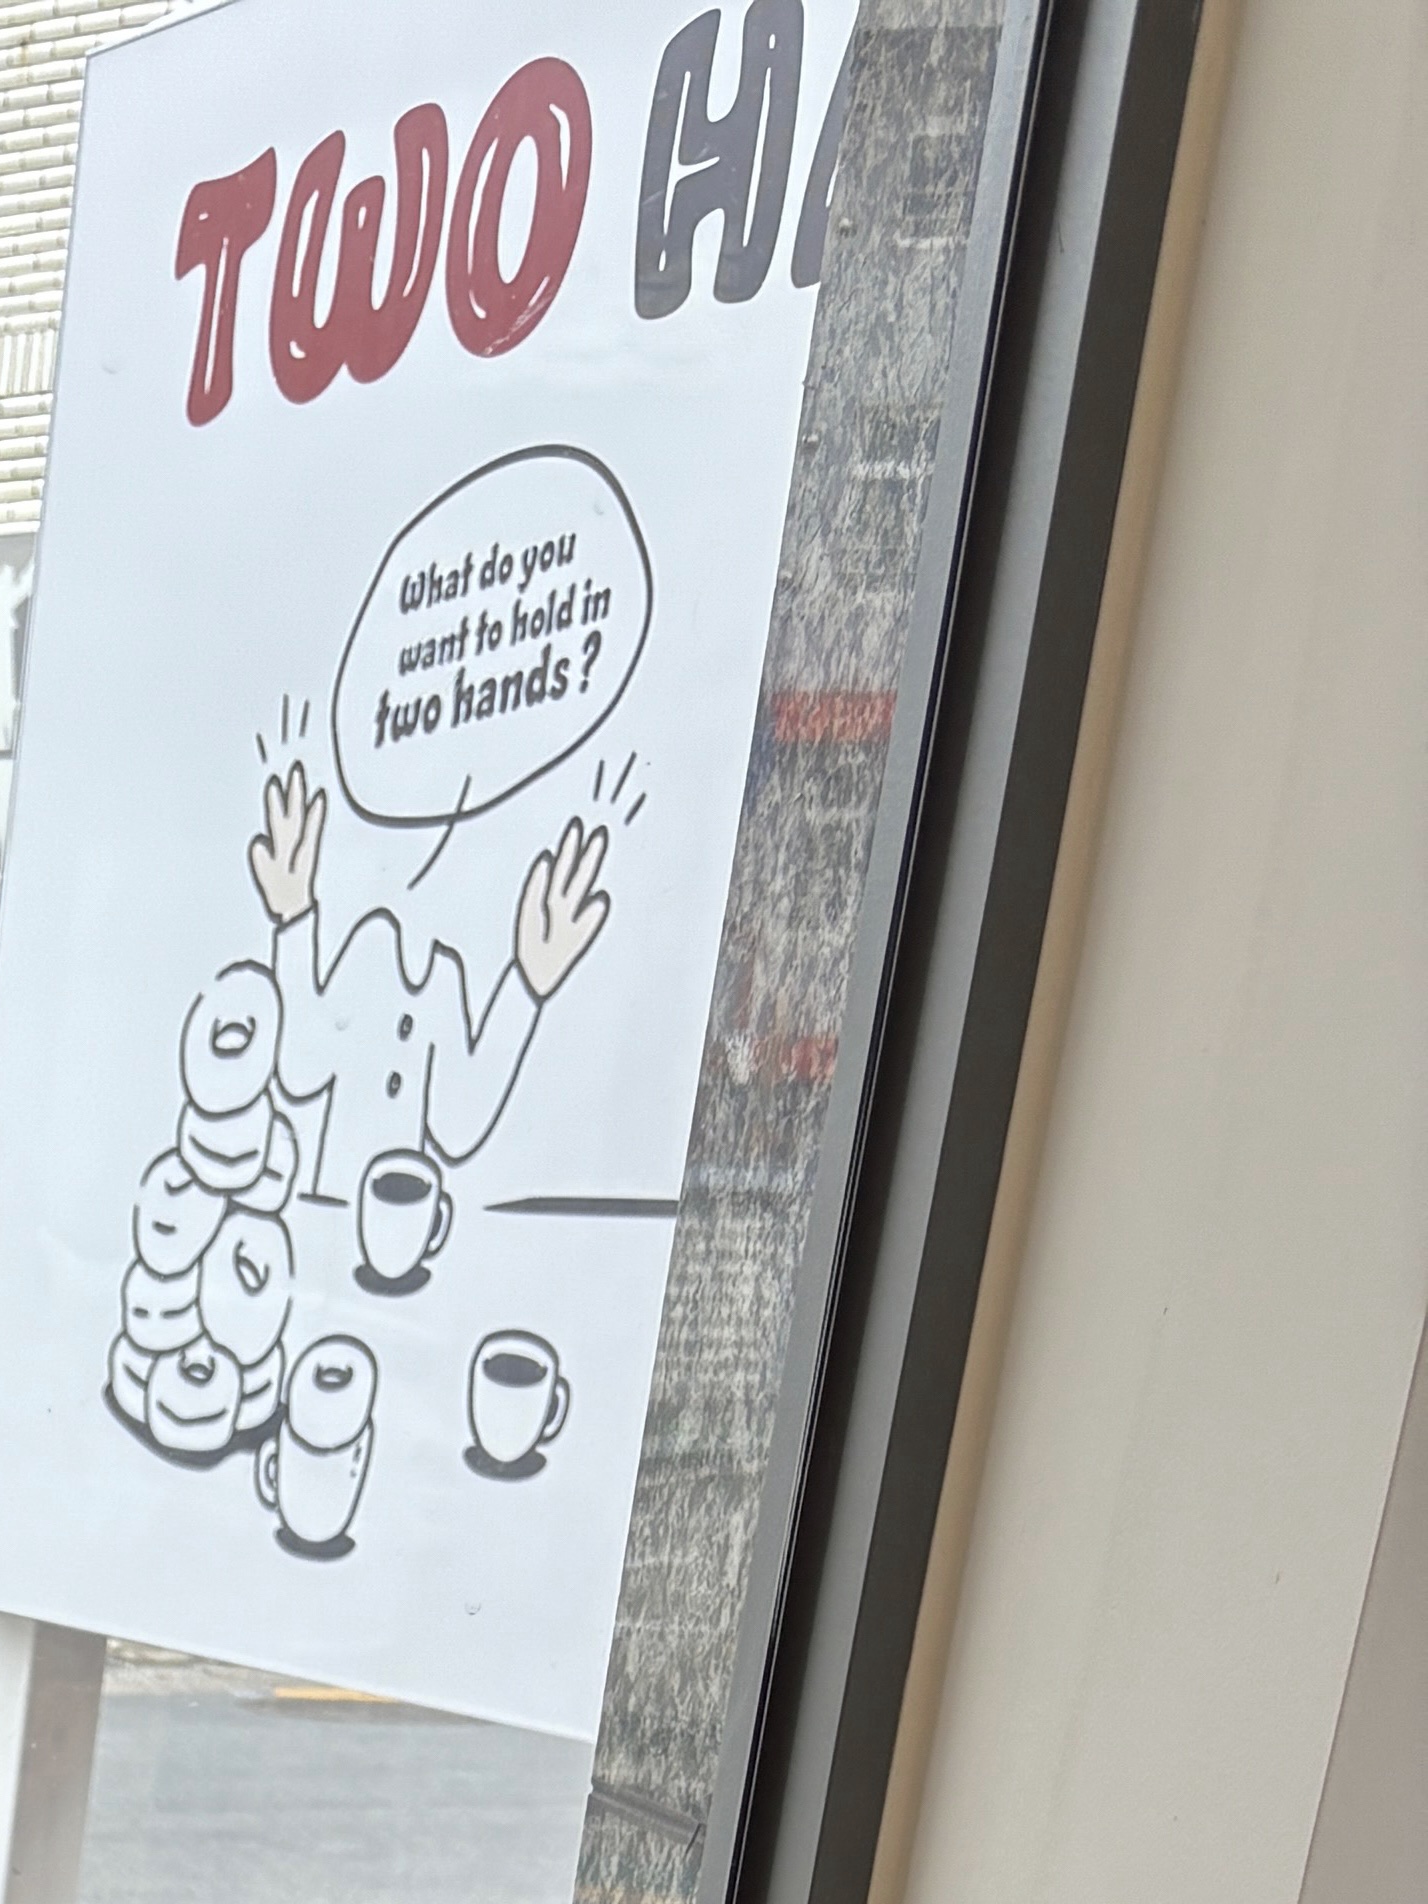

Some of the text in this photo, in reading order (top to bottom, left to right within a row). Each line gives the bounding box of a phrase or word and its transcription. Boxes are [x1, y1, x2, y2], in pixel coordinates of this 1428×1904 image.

[174, 0, 851, 428] TWO H
[399, 532, 576, 615] What do you
[398, 578, 612, 677] want to hold in
[374, 688, 442, 749] two
